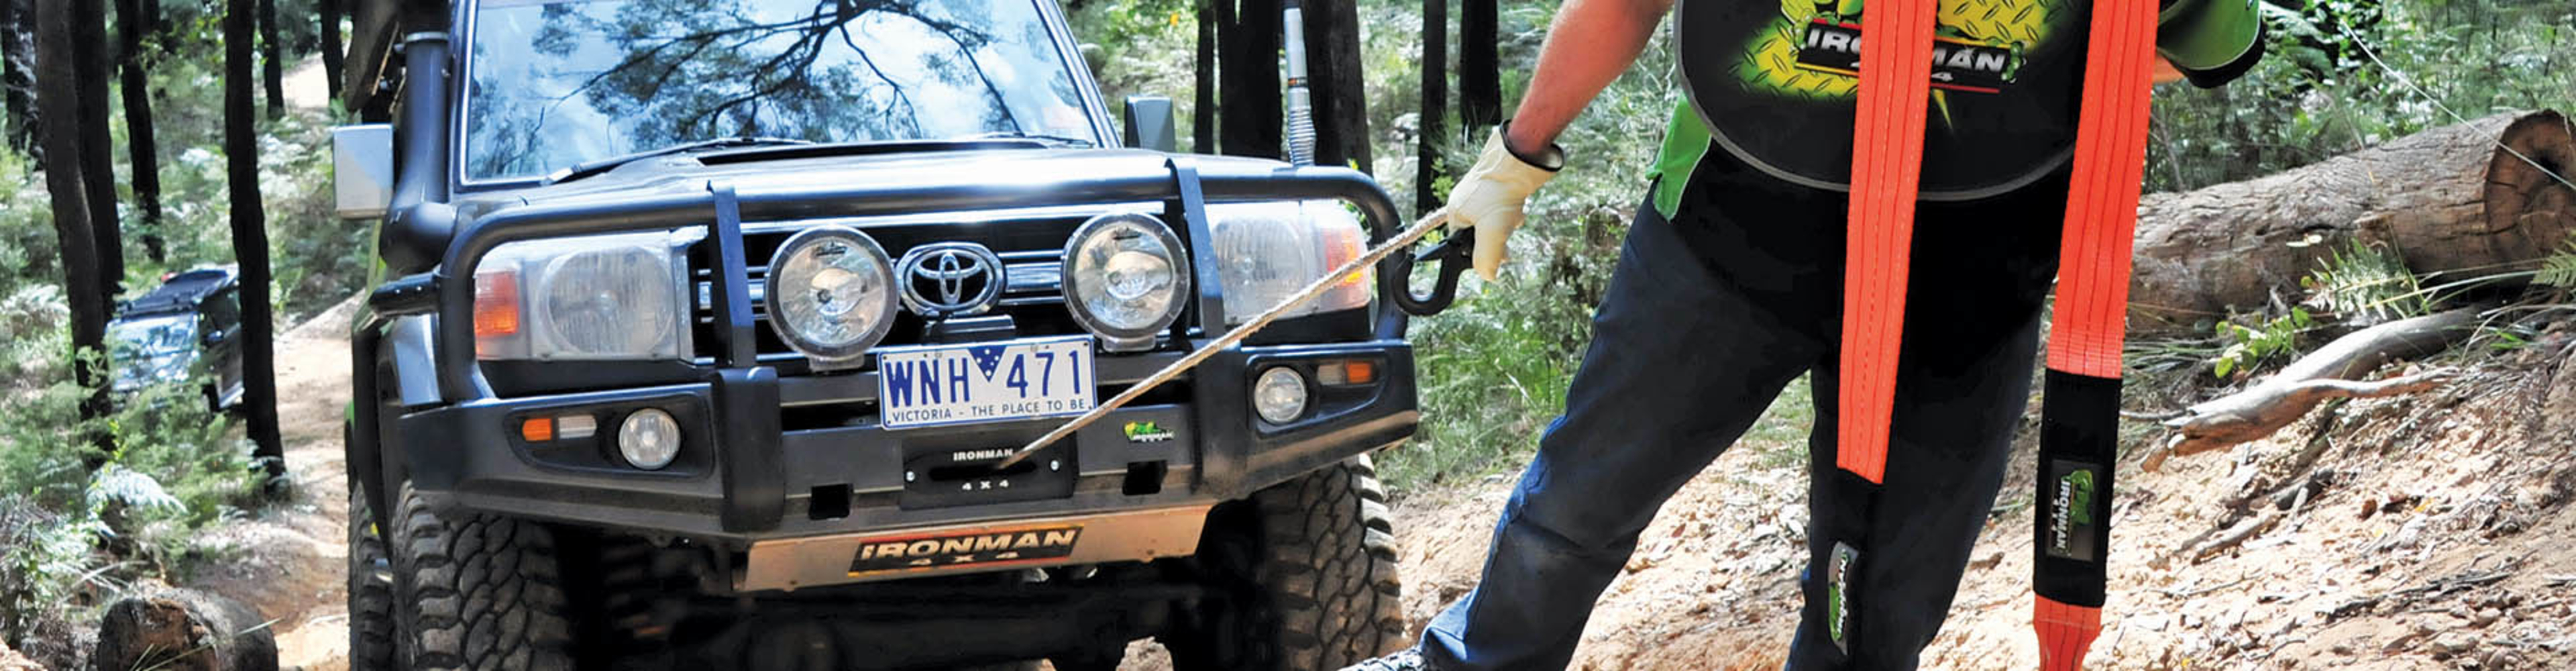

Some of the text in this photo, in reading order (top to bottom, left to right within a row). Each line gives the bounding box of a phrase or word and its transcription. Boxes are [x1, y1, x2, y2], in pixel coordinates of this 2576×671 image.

[885, 350, 1081, 408] WNH 471
[892, 408, 952, 422] VICTORIA
[971, 404, 994, 417] THE
[1002, 402, 1040, 414] PLACE
[1047, 400, 1063, 411] TO
[1070, 399, 1085, 409] BE
[953, 448, 1013, 461] IRONMAN
[961, 482, 972, 491] 4
[999, 480, 1009, 488] 4
[2057, 480, 2071, 549] IRONMAN
[861, 529, 1076, 560] IRONMAN
